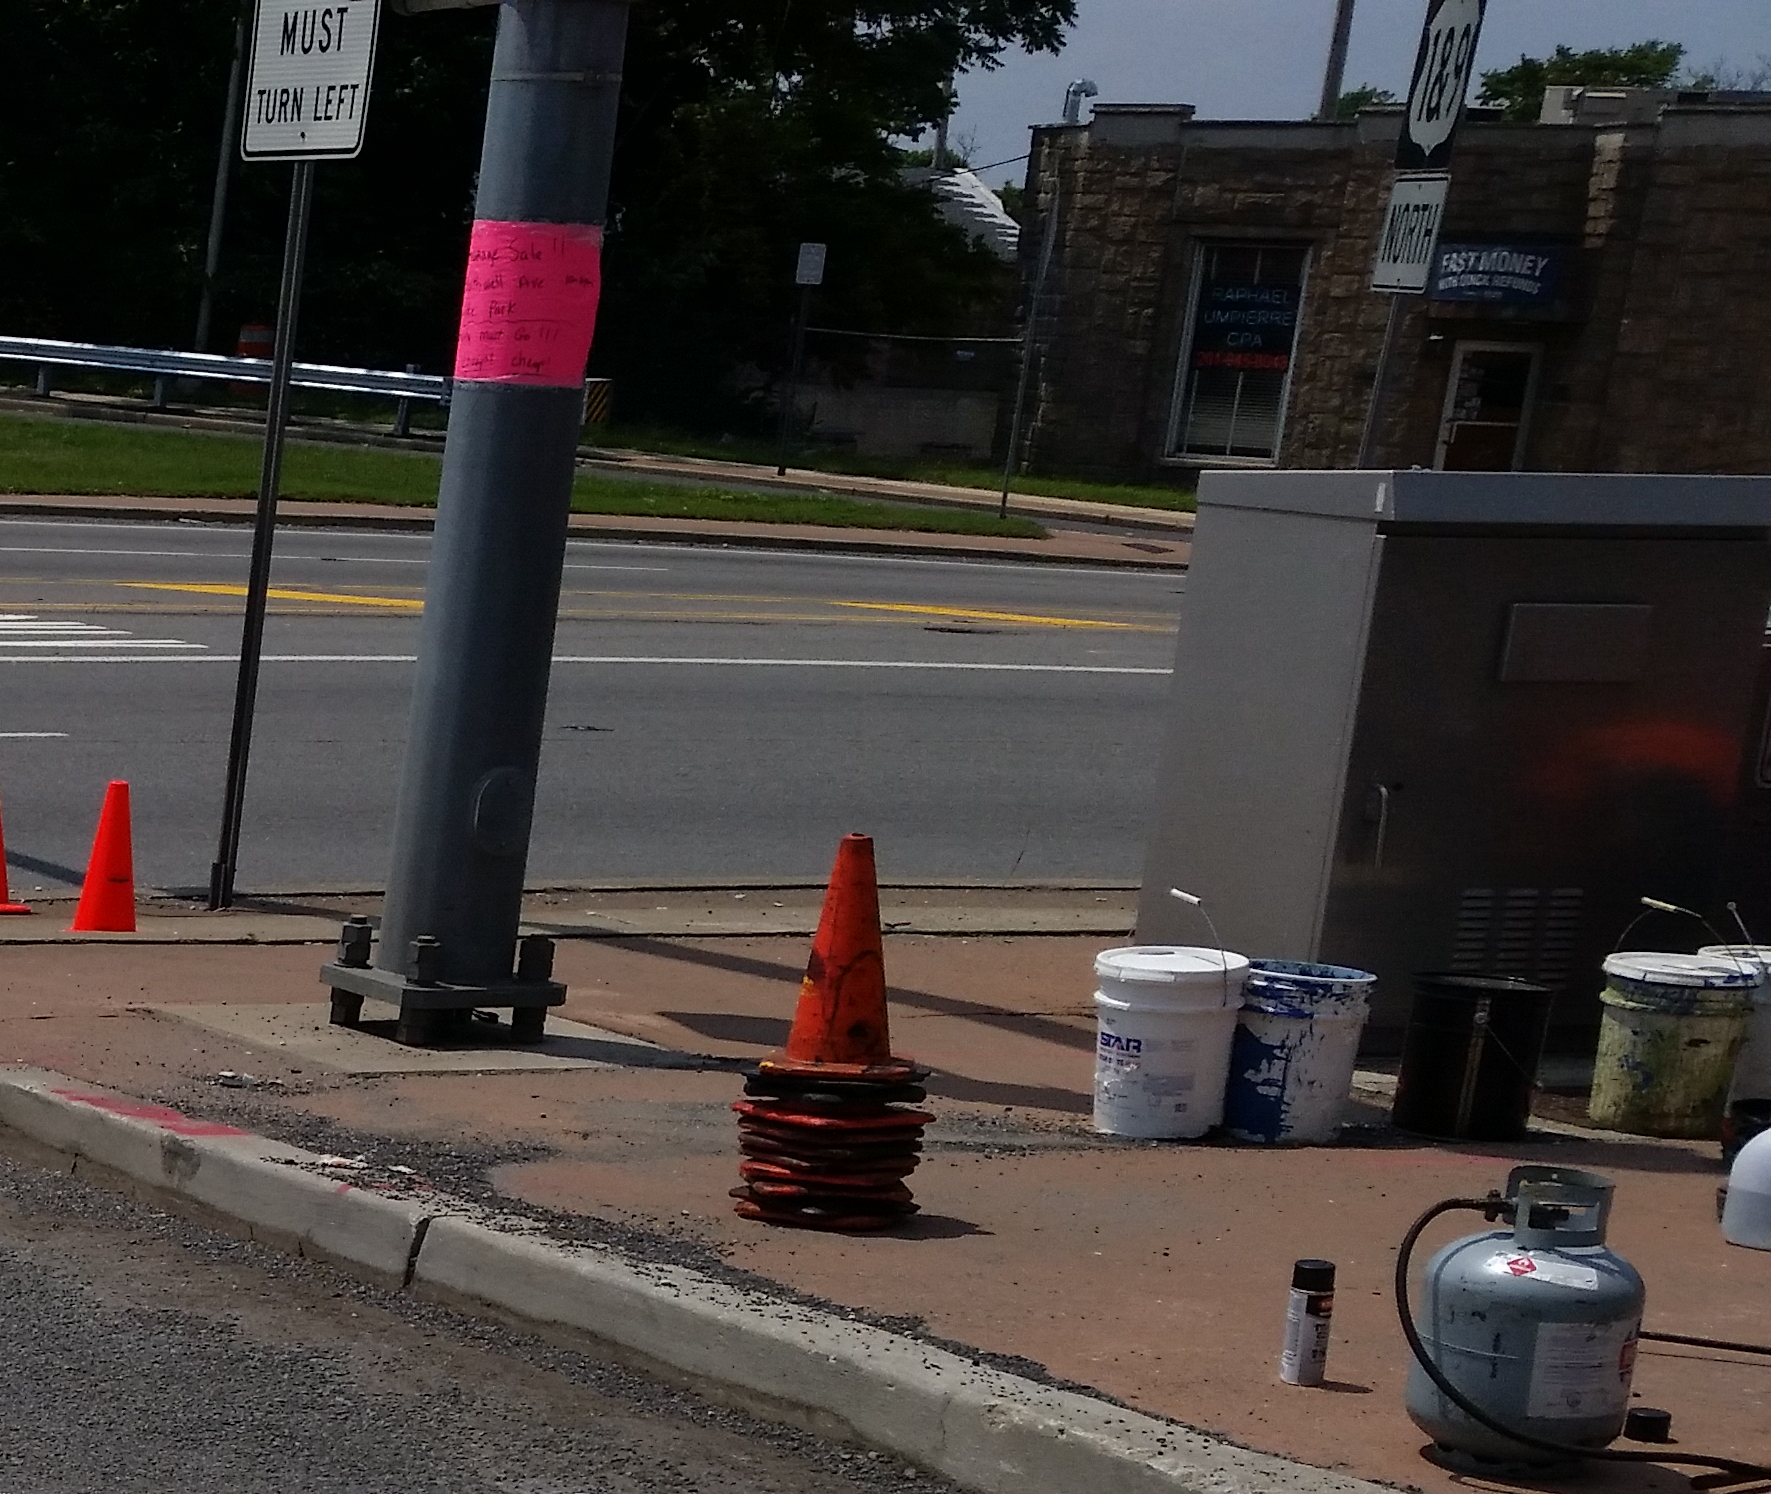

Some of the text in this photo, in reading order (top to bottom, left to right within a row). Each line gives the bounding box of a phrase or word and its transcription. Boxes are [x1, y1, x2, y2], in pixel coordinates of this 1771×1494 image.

[280, 7, 349, 56] MUST
[1416, 23, 1472, 123] 1&9
[257, 83, 359, 124] TURN LEFT
[1381, 203, 1440, 264] NORTH
[1442, 251, 1550, 277] FAST MONEY
[1212, 286, 1290, 304] RAPHAEL
[1204, 309, 1295, 326] UMPIERRE
[1226, 331, 1263, 348] CPA
